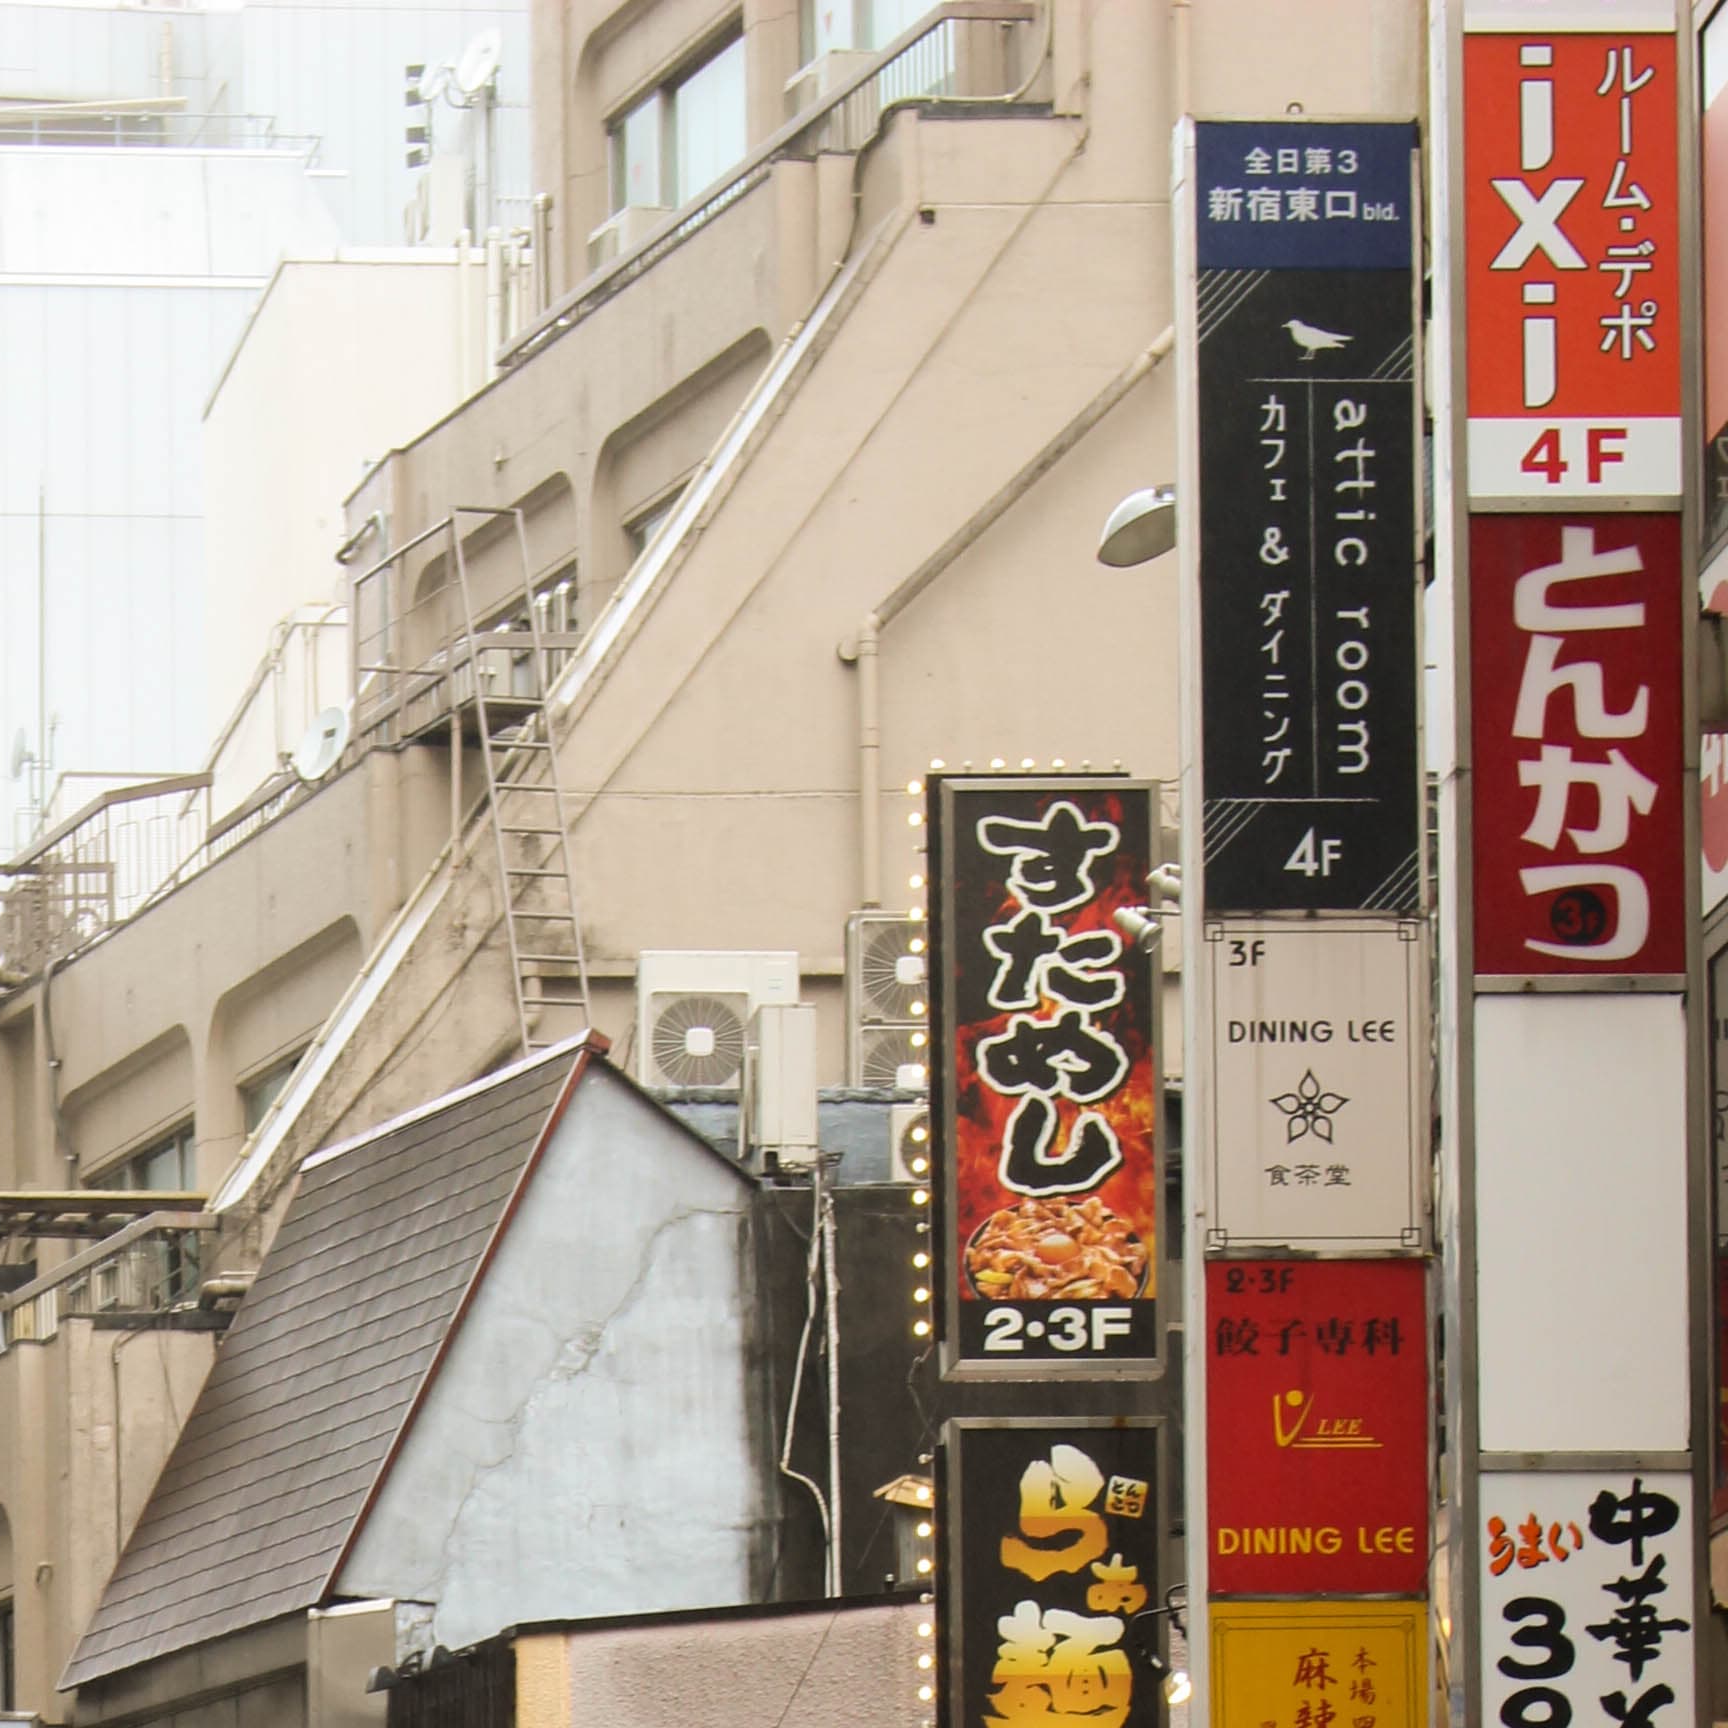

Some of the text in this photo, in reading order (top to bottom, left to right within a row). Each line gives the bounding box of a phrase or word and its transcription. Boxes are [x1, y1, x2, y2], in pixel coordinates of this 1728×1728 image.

[1244, 147, 1358, 175] 全日第3
[1208, 187, 1400, 222] 新宿東口 bld.
[1597, 46, 1657, 360] ルーム・デポ
[1521, 428, 1630, 485] 4F
[1258, 394, 1292, 786] カフェ & ダイニング
[1334, 398, 1377, 776] attic room
[1512, 525, 1659, 962] とんかつ
[1283, 827, 1343, 877] 4F
[1228, 940, 1266, 967] 3F
[976, 800, 1130, 1197] すためし
[1228, 1020, 1395, 1042] DINING LEE
[1264, 1164, 1352, 1187] 食茶堂
[1216, 1315, 1404, 1356] 餃子専科
[1315, 1418, 1363, 1436] LEE
[1218, 1526, 1415, 1554] DINING LEE
[1487, 1512, 1583, 1577] うまい
